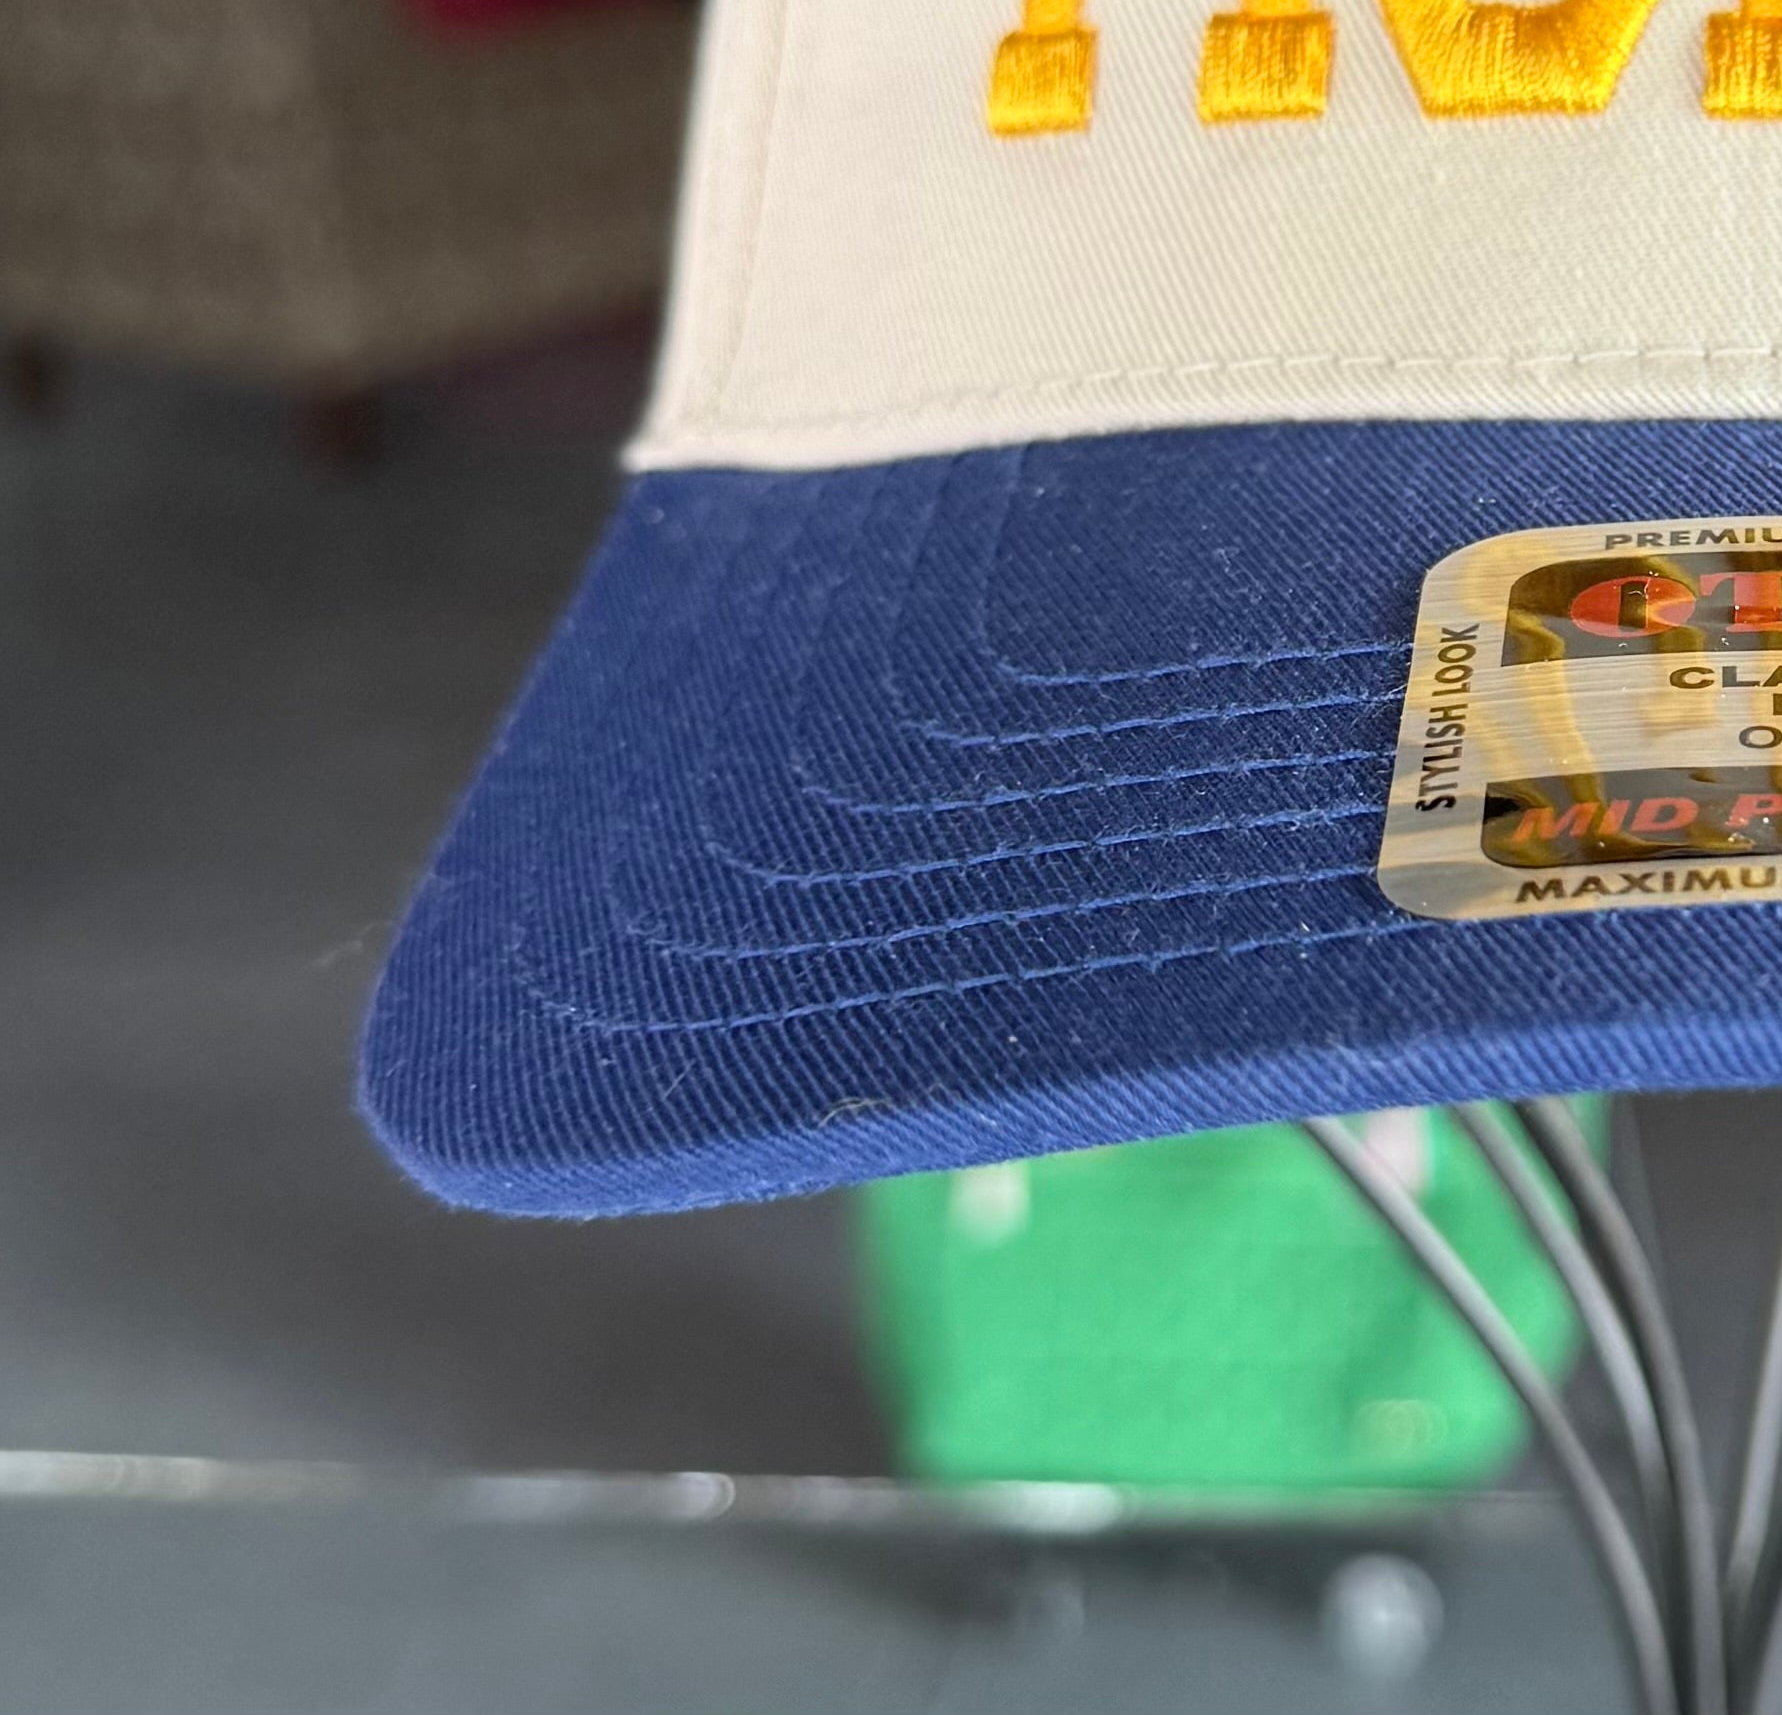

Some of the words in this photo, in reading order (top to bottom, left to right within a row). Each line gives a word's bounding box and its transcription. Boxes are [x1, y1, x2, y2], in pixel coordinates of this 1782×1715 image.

[1431, 623, 1480, 697] LOOK
[1415, 703, 1468, 812] STYLISH
[1511, 796, 1699, 842] MID
